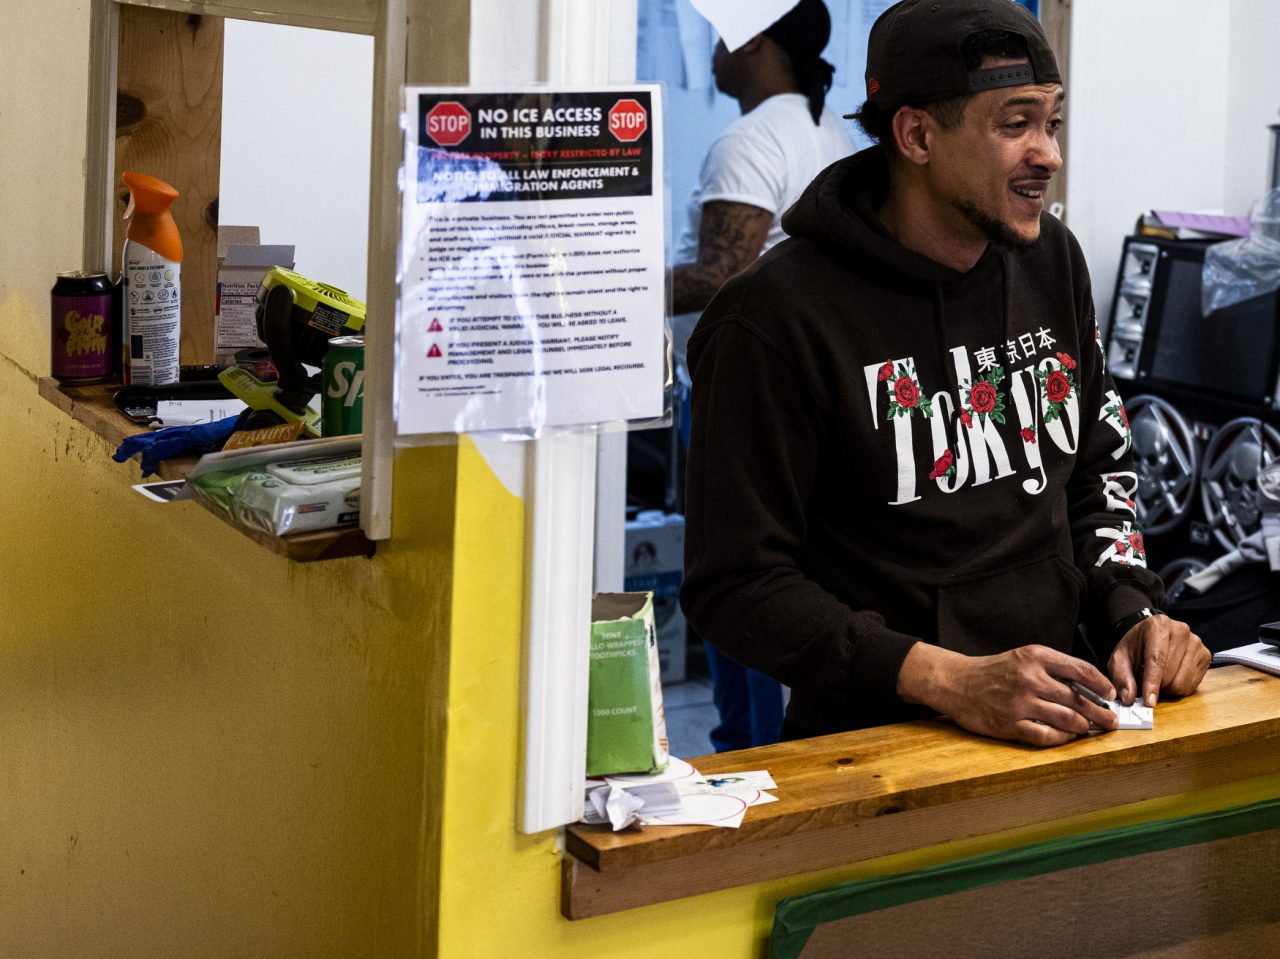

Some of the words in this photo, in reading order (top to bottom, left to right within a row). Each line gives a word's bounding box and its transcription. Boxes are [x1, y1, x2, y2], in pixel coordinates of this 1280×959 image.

[478, 108, 508, 123] NO
[513, 107, 540, 123] ICE
[542, 107, 603, 123] ACCESS
[611, 112, 645, 129] STOP
[429, 116, 469, 133] STOP
[480, 127, 498, 139] IN
[501, 126, 532, 139] THIS
[536, 125, 601, 138] BUSINESS
[560, 148, 608, 158] RESTRICTED
[609, 149, 620, 157] BY
[622, 147, 641, 157] LAW
[500, 170, 520, 181] ALL
[523, 169, 549, 180] LAW
[551, 167, 630, 179] ENFORCEMENT
[632, 167, 639, 176] &
[560, 179, 604, 190] AGENTS
[601, 631, 622, 640] MINT
[611, 705, 639, 716] COUNT
